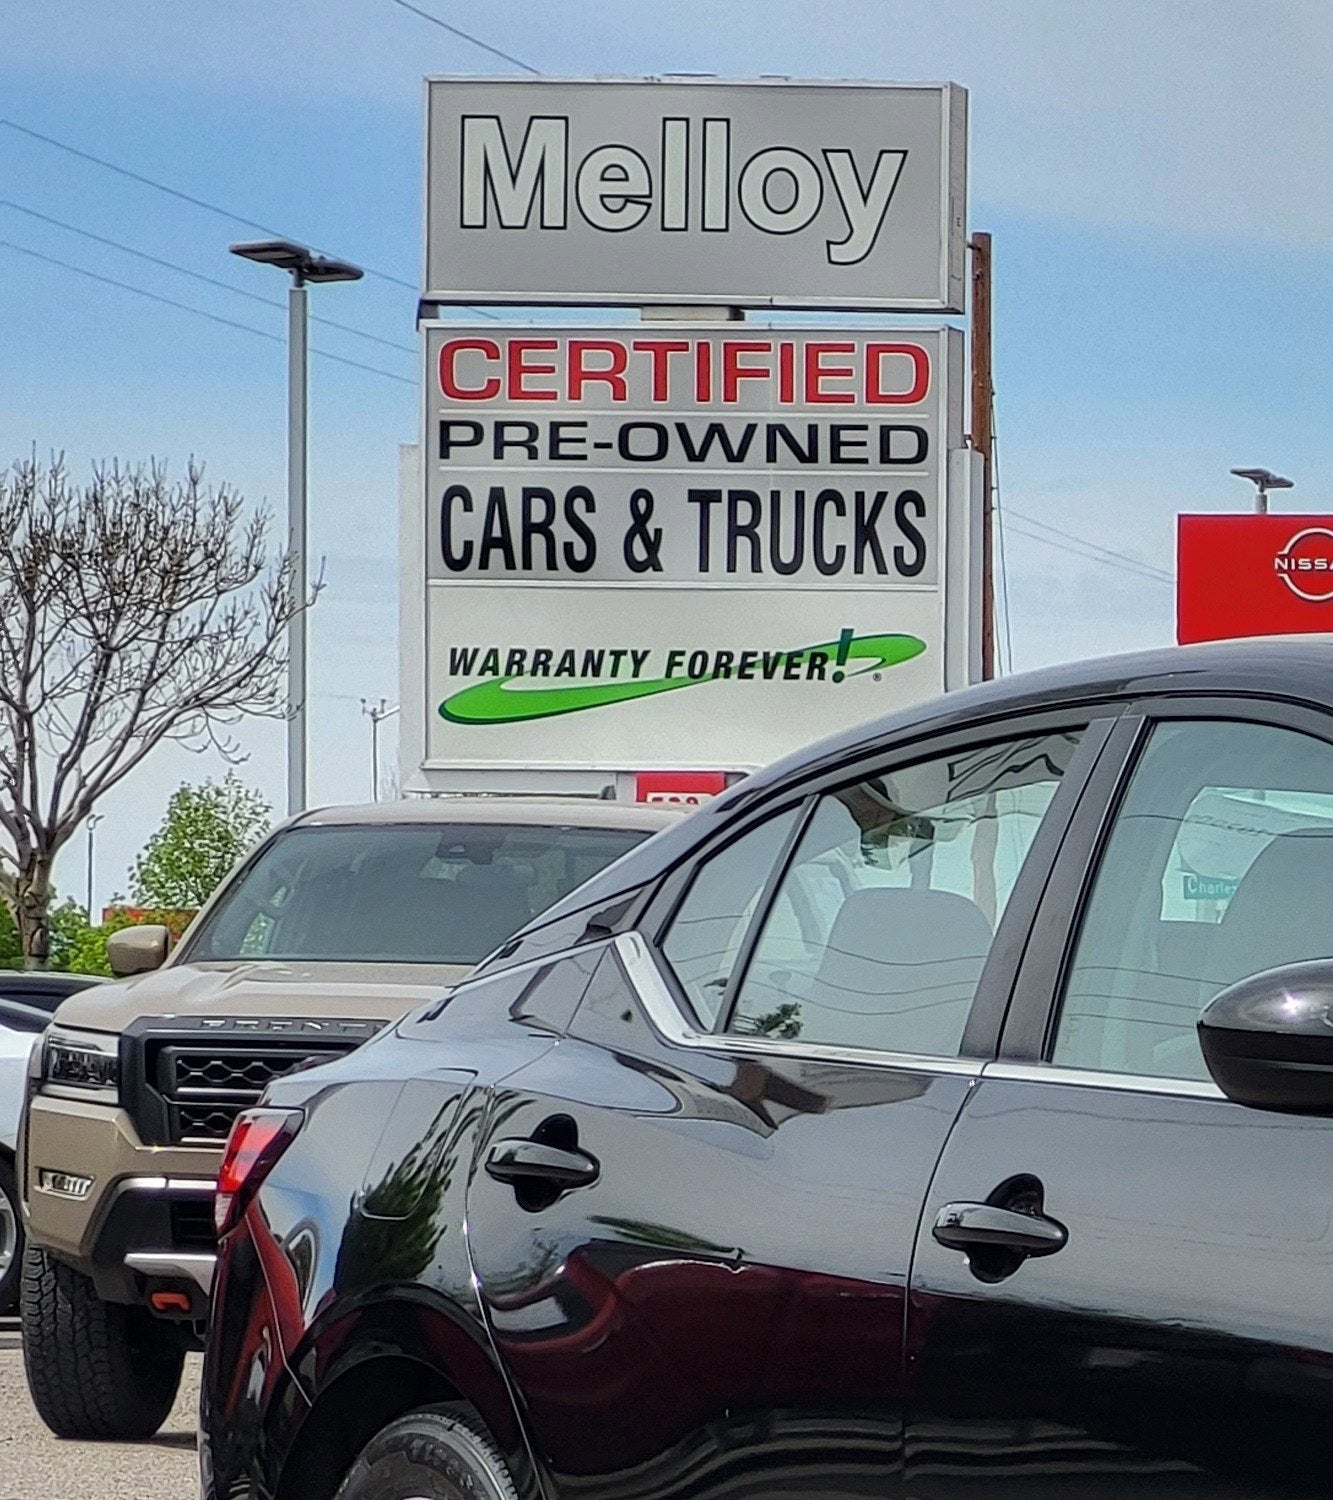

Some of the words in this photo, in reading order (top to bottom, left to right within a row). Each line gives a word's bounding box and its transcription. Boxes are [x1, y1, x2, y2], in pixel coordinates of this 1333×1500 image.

[460, 114, 909, 266] Melloy
[437, 338, 931, 405] CERTIFIED
[438, 419, 930, 466] PRE-OWNED
[440, 484, 597, 573] CARS
[623, 488, 663, 573] &
[687, 489, 927, 578] TRUCKS
[448, 646, 651, 679] WARRANTY
[665, 628, 855, 684] FOREVER!
